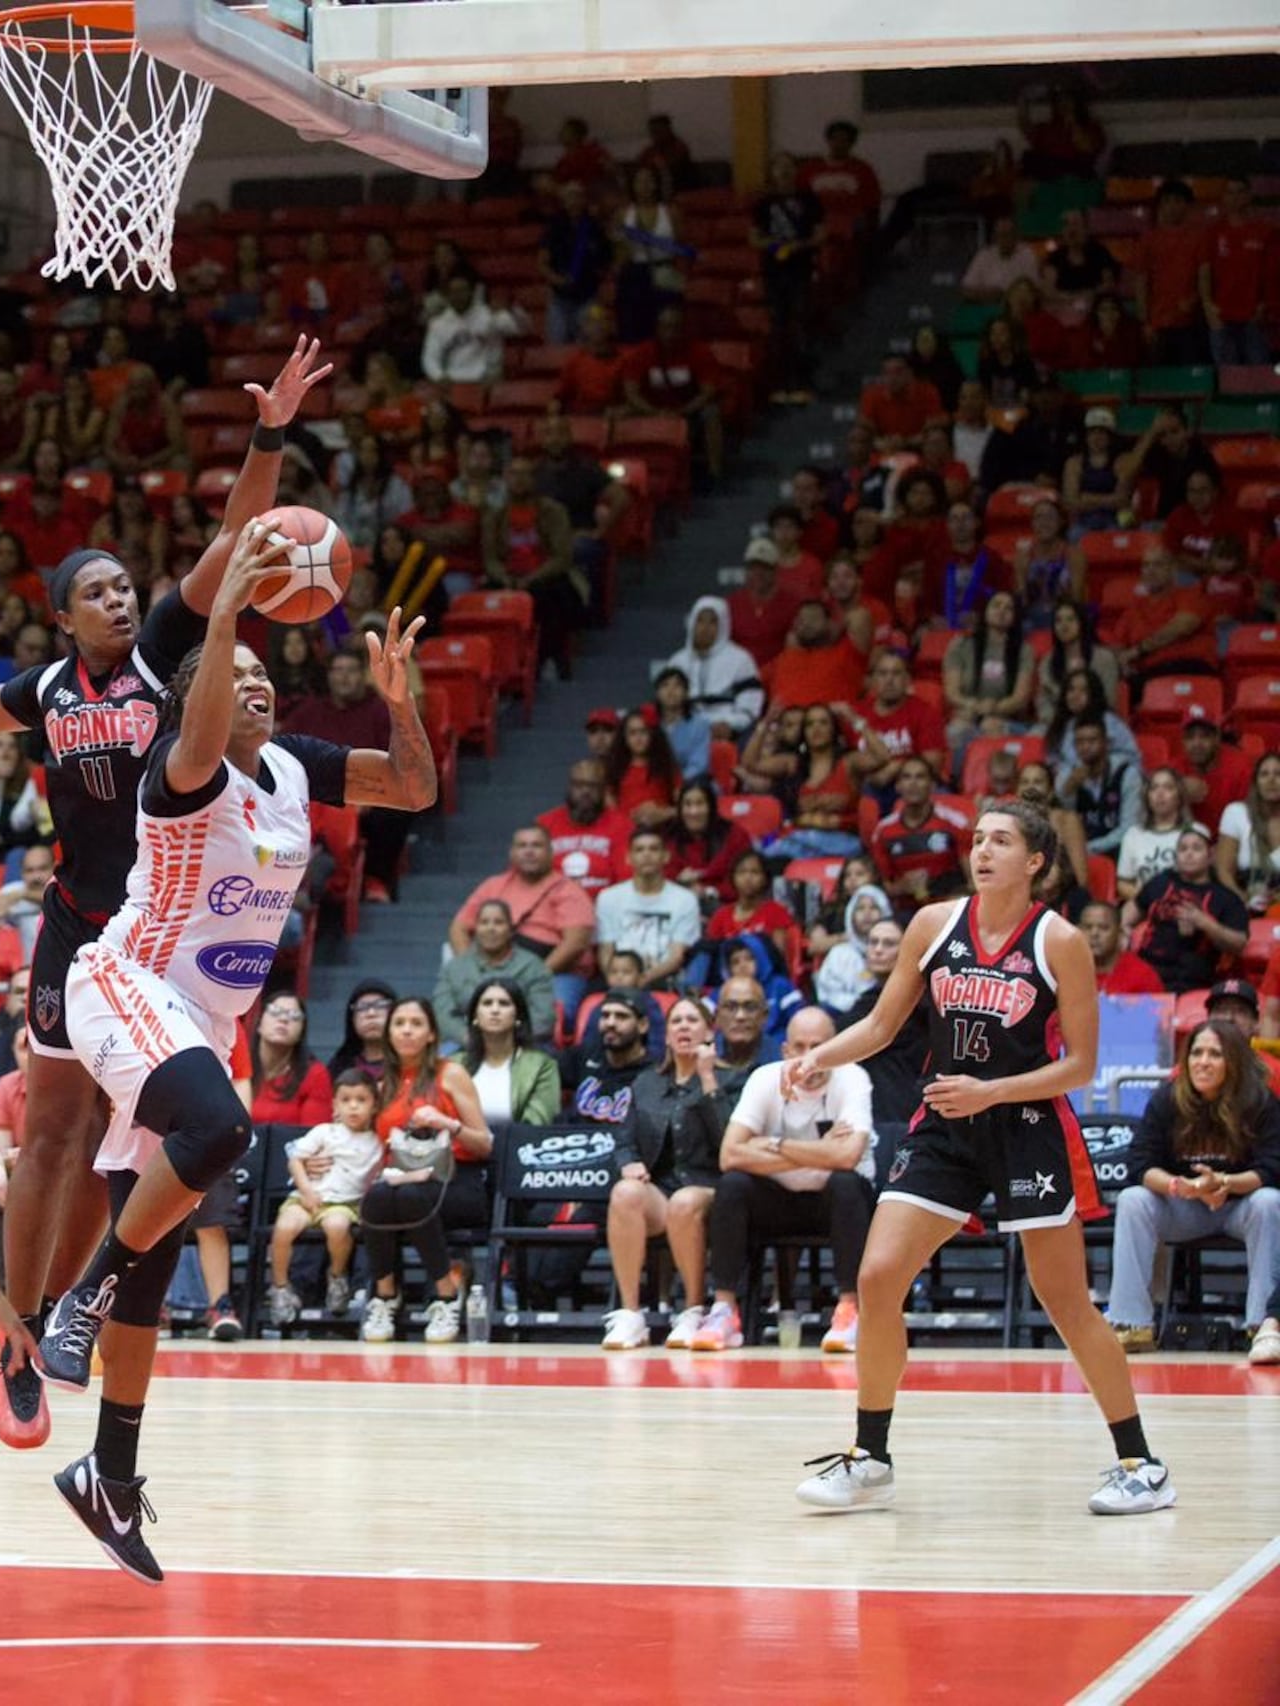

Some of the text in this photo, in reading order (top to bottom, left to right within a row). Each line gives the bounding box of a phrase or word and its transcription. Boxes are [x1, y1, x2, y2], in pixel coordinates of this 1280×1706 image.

[44, 699, 159, 767] GIGANTES
[79, 755, 117, 801] 11
[930, 965, 1038, 1029] GIGANTES
[952, 1018, 991, 1062] 14
[520, 1168, 611, 1189] ABONADO
